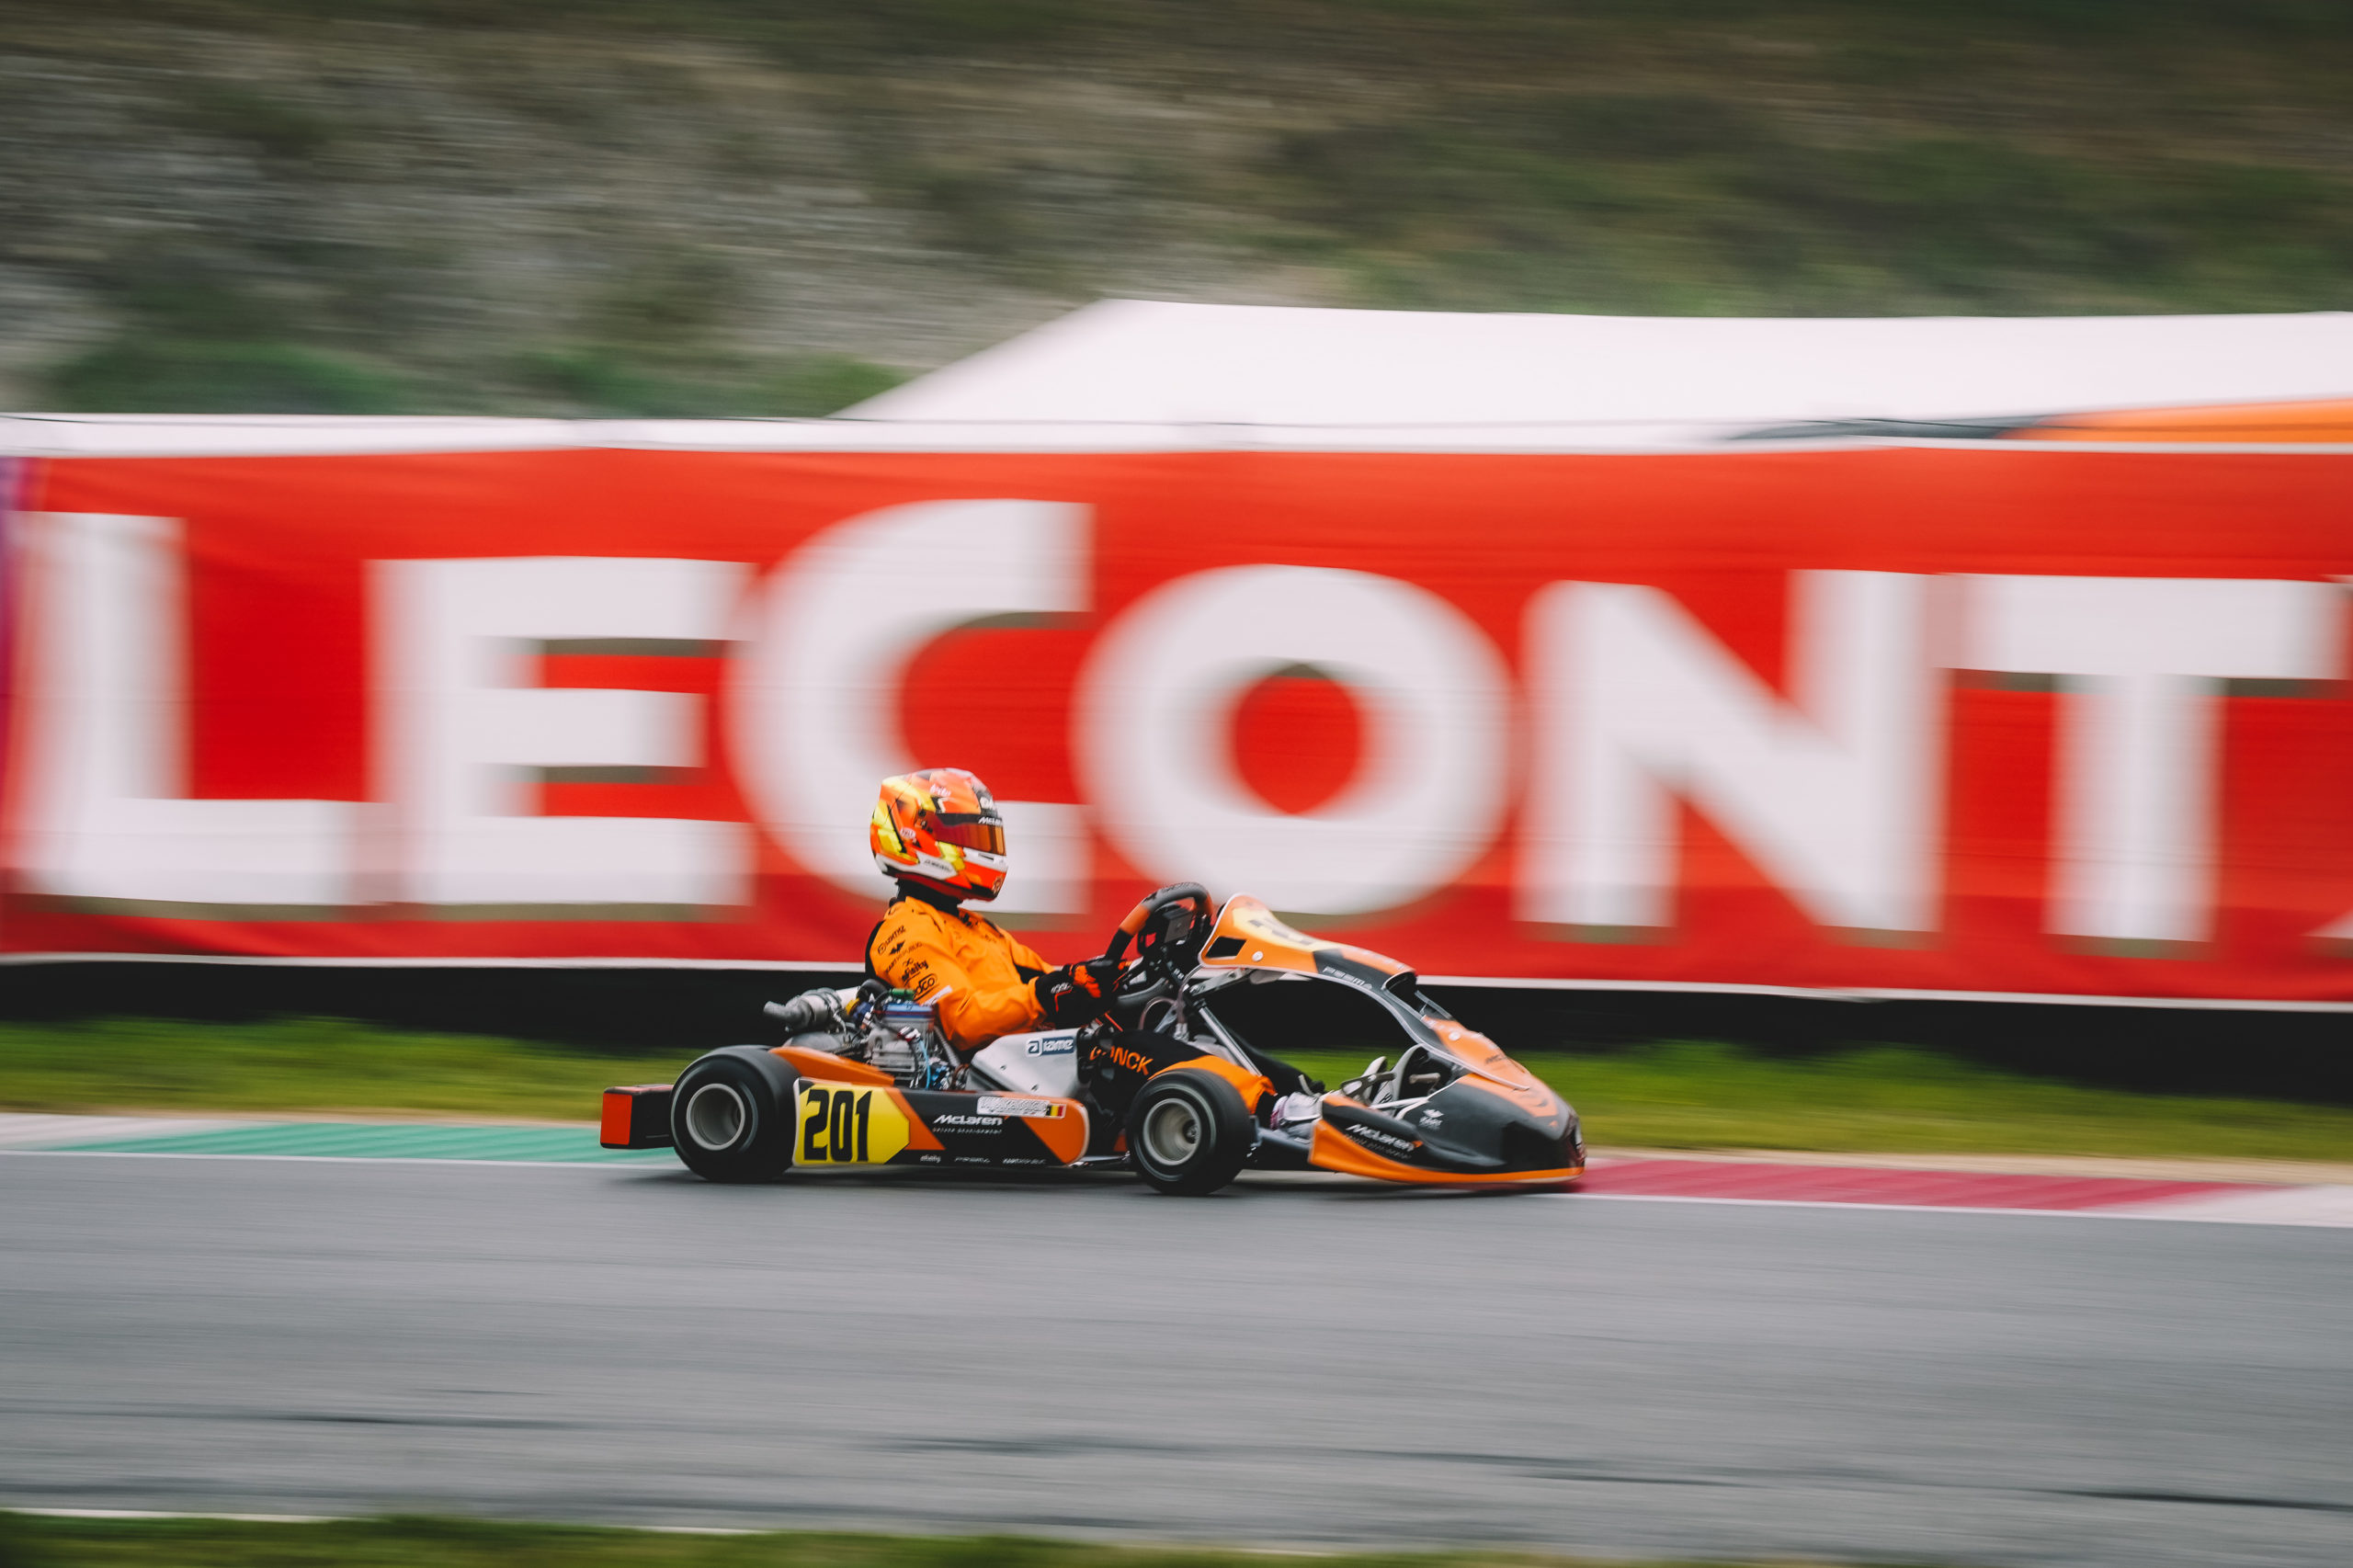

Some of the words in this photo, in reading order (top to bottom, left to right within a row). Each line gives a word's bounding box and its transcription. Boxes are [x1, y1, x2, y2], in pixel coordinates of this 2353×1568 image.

[804, 1089, 870, 1162] 201
[932, 1114, 1003, 1126] McLaren
[1346, 1124, 1415, 1152] McLaren
